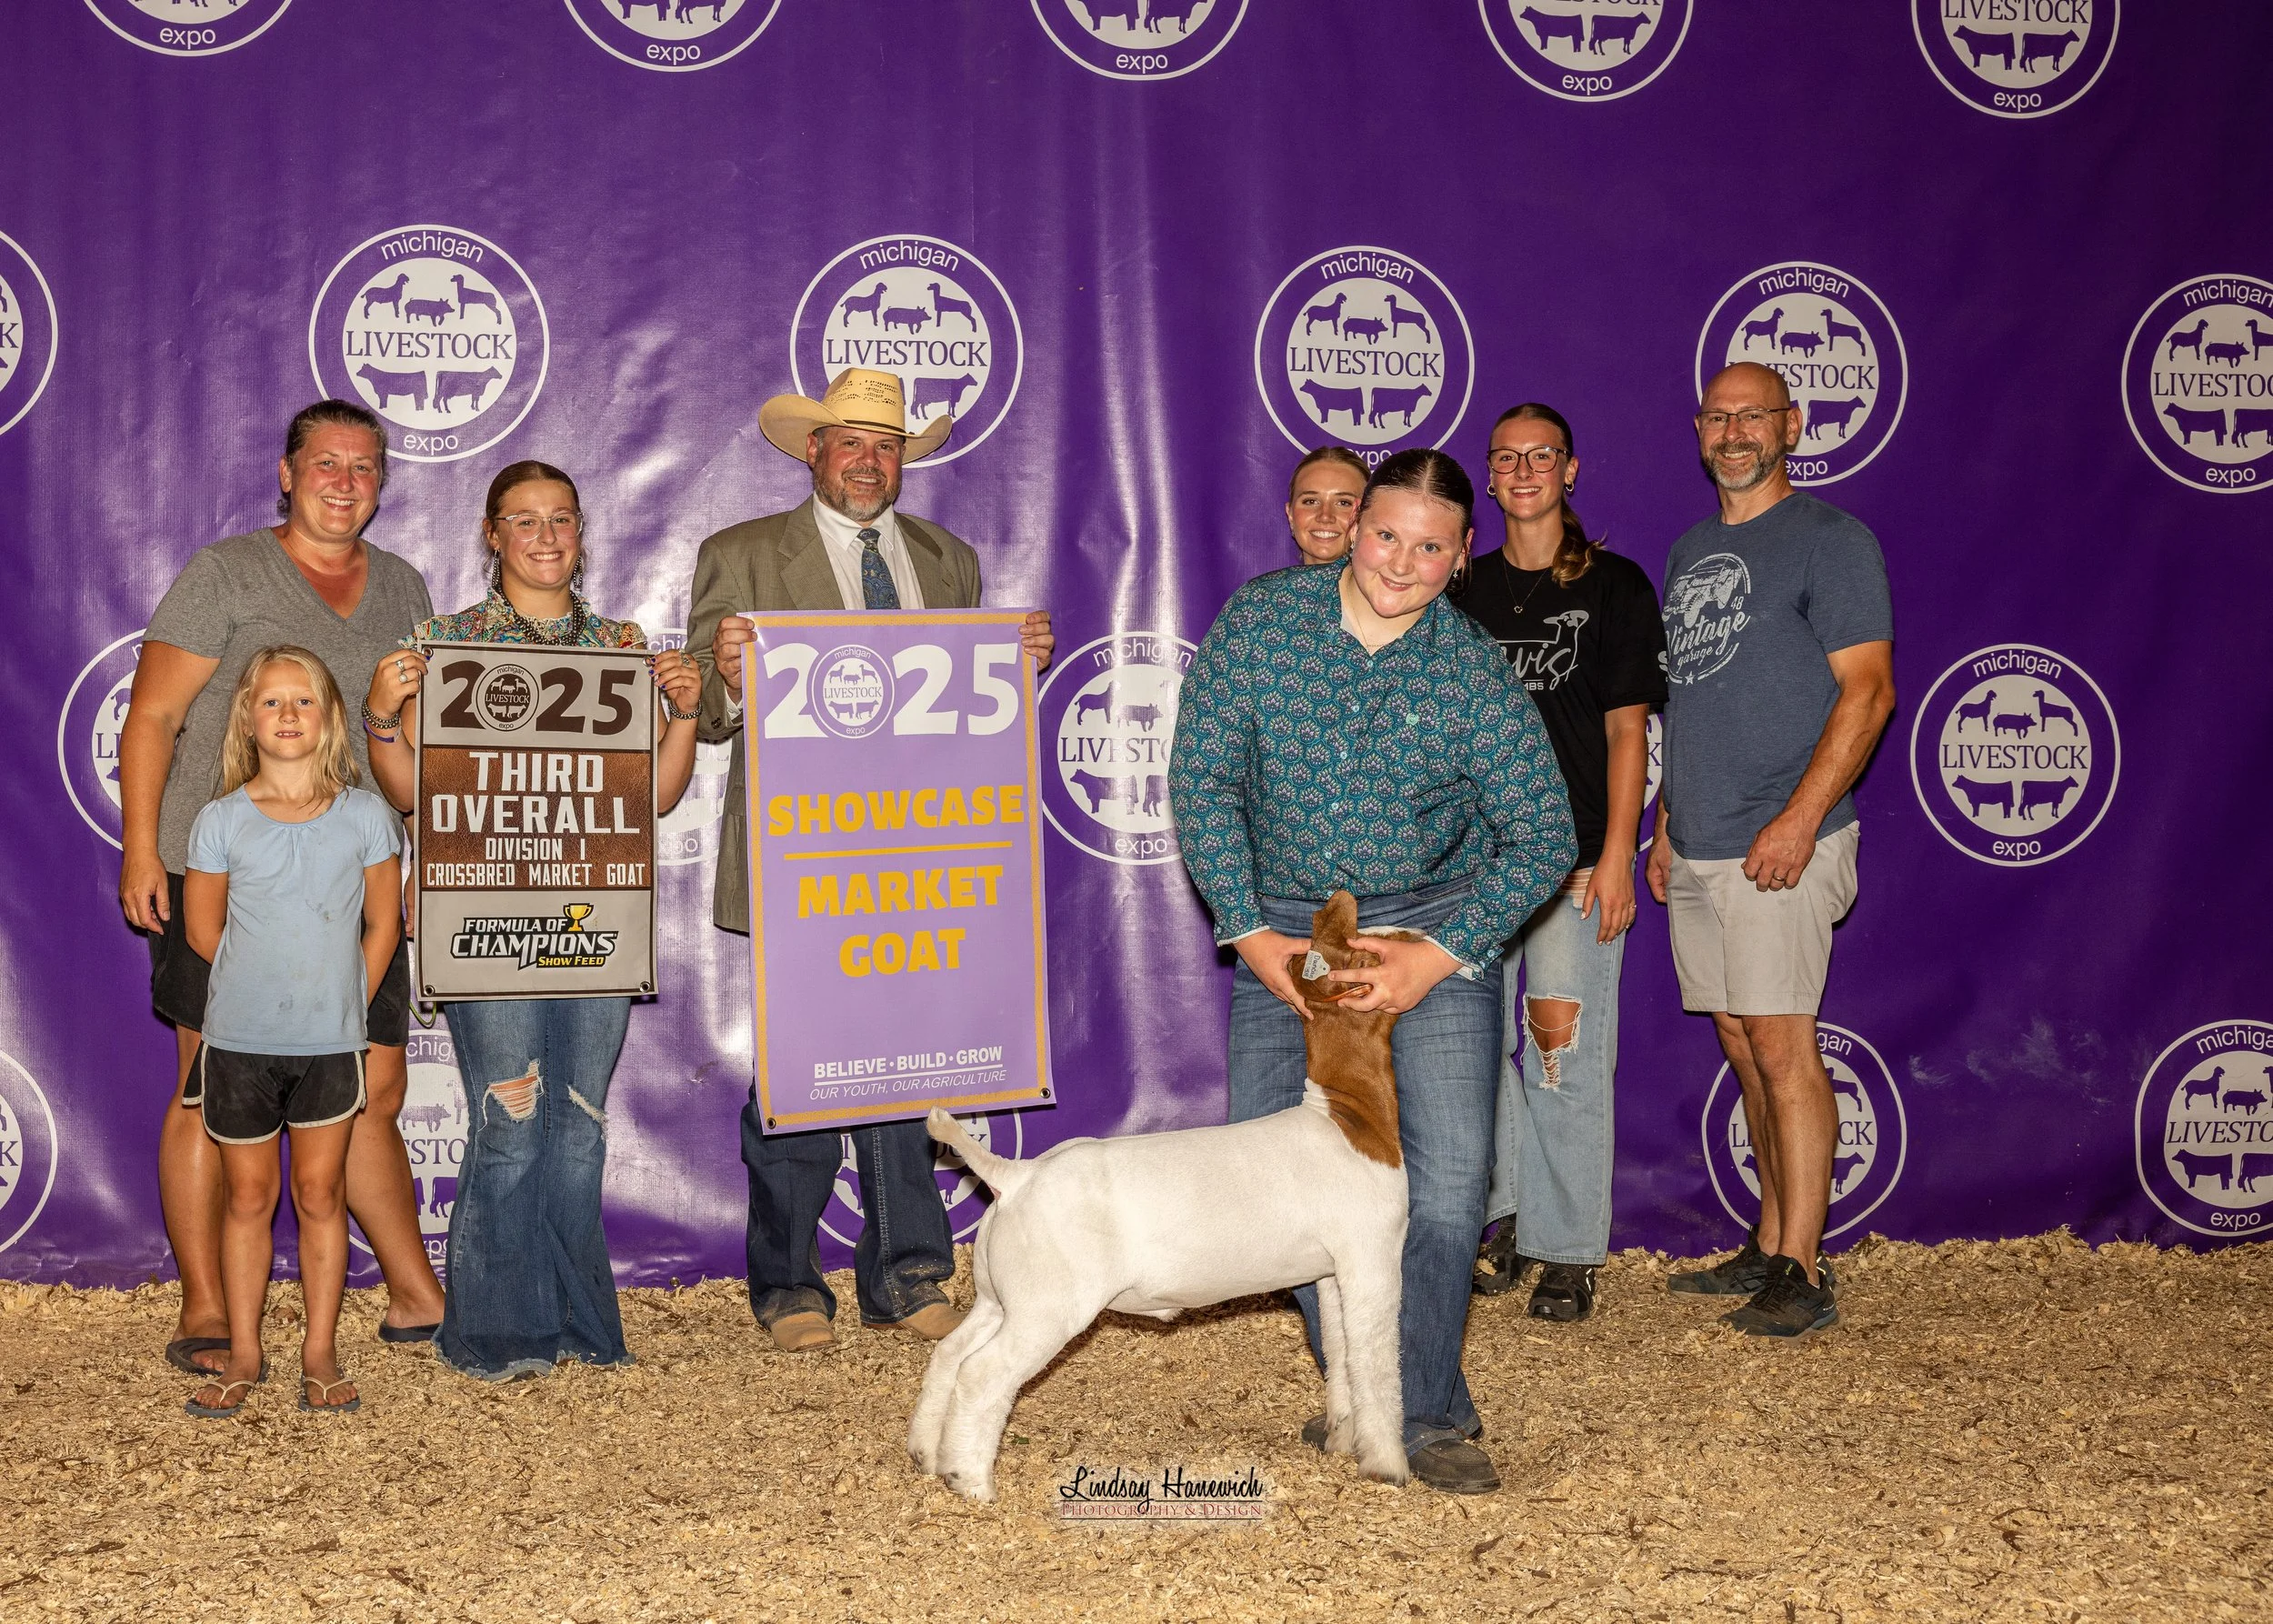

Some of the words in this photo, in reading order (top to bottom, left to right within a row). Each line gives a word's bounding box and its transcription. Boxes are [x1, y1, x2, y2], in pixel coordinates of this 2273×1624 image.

[1944, 0, 2089, 24] LIVESTOCK
[159, 27, 216, 50] expo
[646, 44, 701, 66] expo
[1116, 54, 1168, 75] expo
[1562, 75, 1613, 95] expo
[1994, 92, 2042, 113] expo
[380, 231, 484, 263] michigan
[859, 241, 959, 272] michigan
[1320, 252, 1415, 284] michigan
[1758, 268, 1849, 298] michigan
[345, 330, 513, 360] LIVESTOCK
[826, 338, 987, 367] LIVESTOCK
[1289, 346, 1441, 378] LIVESTOCK
[2153, 372, 2273, 397] LIVESTO
[404, 434, 459, 456] expo
[2206, 467, 2257, 487] expo
[1665, 611, 1751, 656] Vintage
[834, 647, 871, 660] michigan
[1676, 646, 1715, 674] garage
[1973, 650, 2062, 678] michigan
[496, 666, 525, 676] michigan
[486, 693, 530, 704] LIVESTOCK
[824, 687, 882, 699] LIVESTOCK
[846, 727, 866, 737] expo
[1942, 744, 2088, 769] LIVESTOCK
[469, 752, 604, 793] THIRD
[432, 794, 640, 834] OVERALL
[767, 785, 1025, 837] SHOWCASE
[486, 837, 563, 861] DIVISION
[1114, 837, 1168, 860] expo
[1992, 840, 2041, 860] expo
[426, 863, 516, 887] CROSSBRED
[528, 863, 592, 887] MARKET
[606, 863, 646, 886] GOAT
[797, 865, 1004, 919] MARKET
[465, 918, 542, 934] FORMULA
[546, 918, 568, 932] OF
[455, 933, 615, 968] CHAMPIONS
[538, 957, 572, 967] SHOW
[574, 956, 605, 966] FEED
[839, 927, 966, 977] GOAT
[2196, 1026, 2273, 1054] michiga
[809, 1087, 839, 1100] OUR
[843, 1082, 888, 1098] YOUTH,
[892, 1078, 920, 1092] OUR
[921, 1069, 1007, 1089] AGRICULTURE
[2166, 1120, 2273, 1144] LIVESTO
[2210, 1212, 2261, 1231] expo
